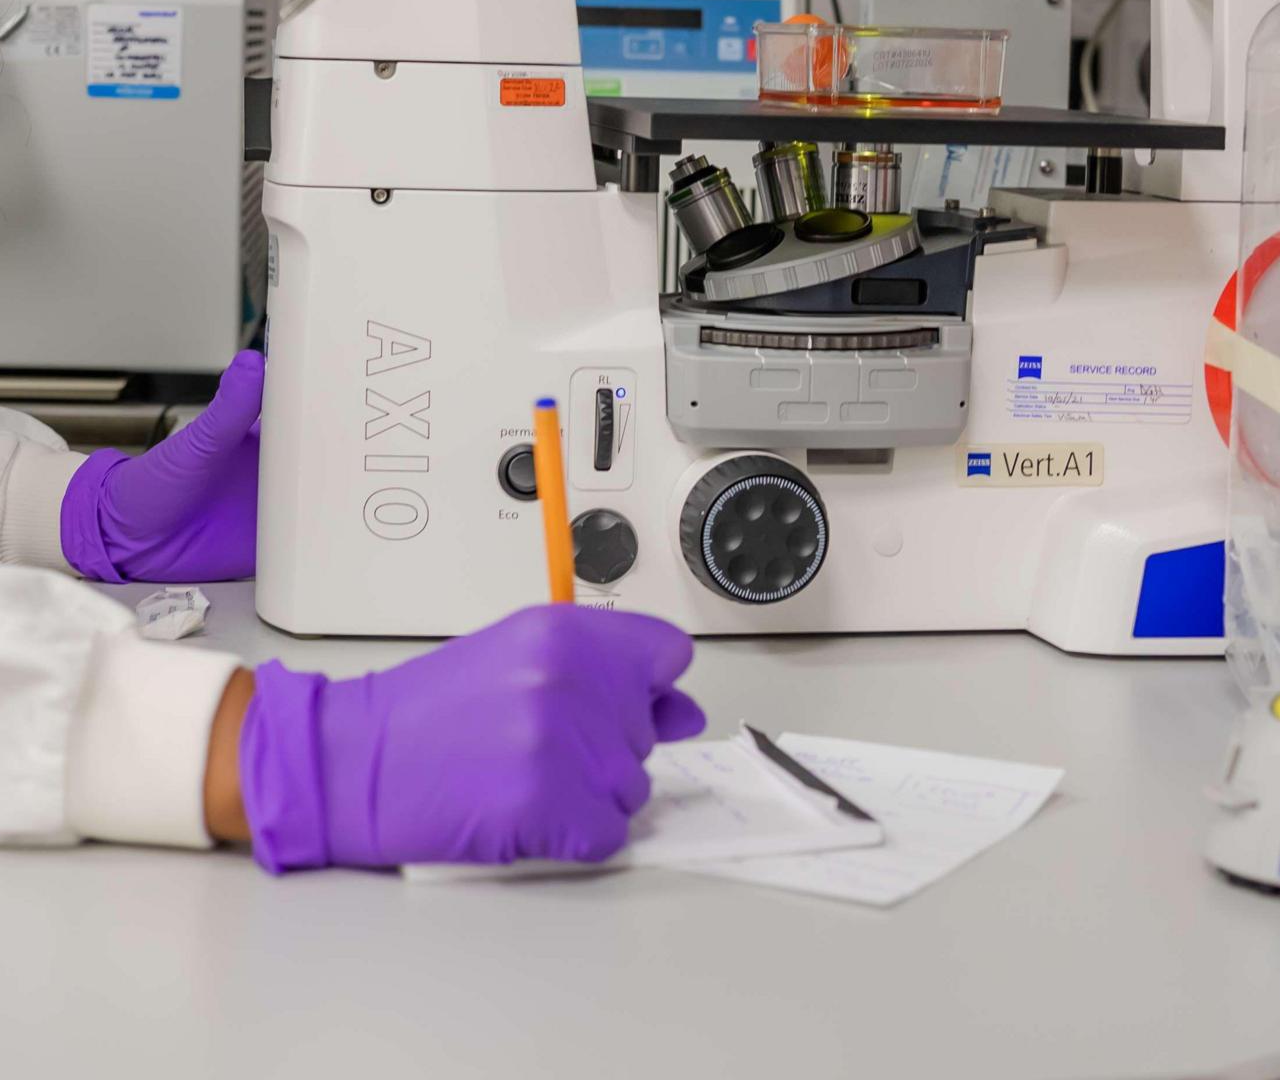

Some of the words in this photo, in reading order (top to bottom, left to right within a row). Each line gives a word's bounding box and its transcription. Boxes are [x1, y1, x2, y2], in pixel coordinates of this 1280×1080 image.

[1019, 361, 1042, 370] ZEISS
[1069, 364, 1112, 375] SERVICE
[1114, 365, 1157, 376] RECORD
[598, 375, 611, 385] RL
[363, 320, 431, 541] AXIO
[500, 427, 564, 438] permat
[968, 458, 991, 467] ZEISS
[1002, 451, 1093, 477] Vert.A1
[498, 509, 519, 520] Eco
